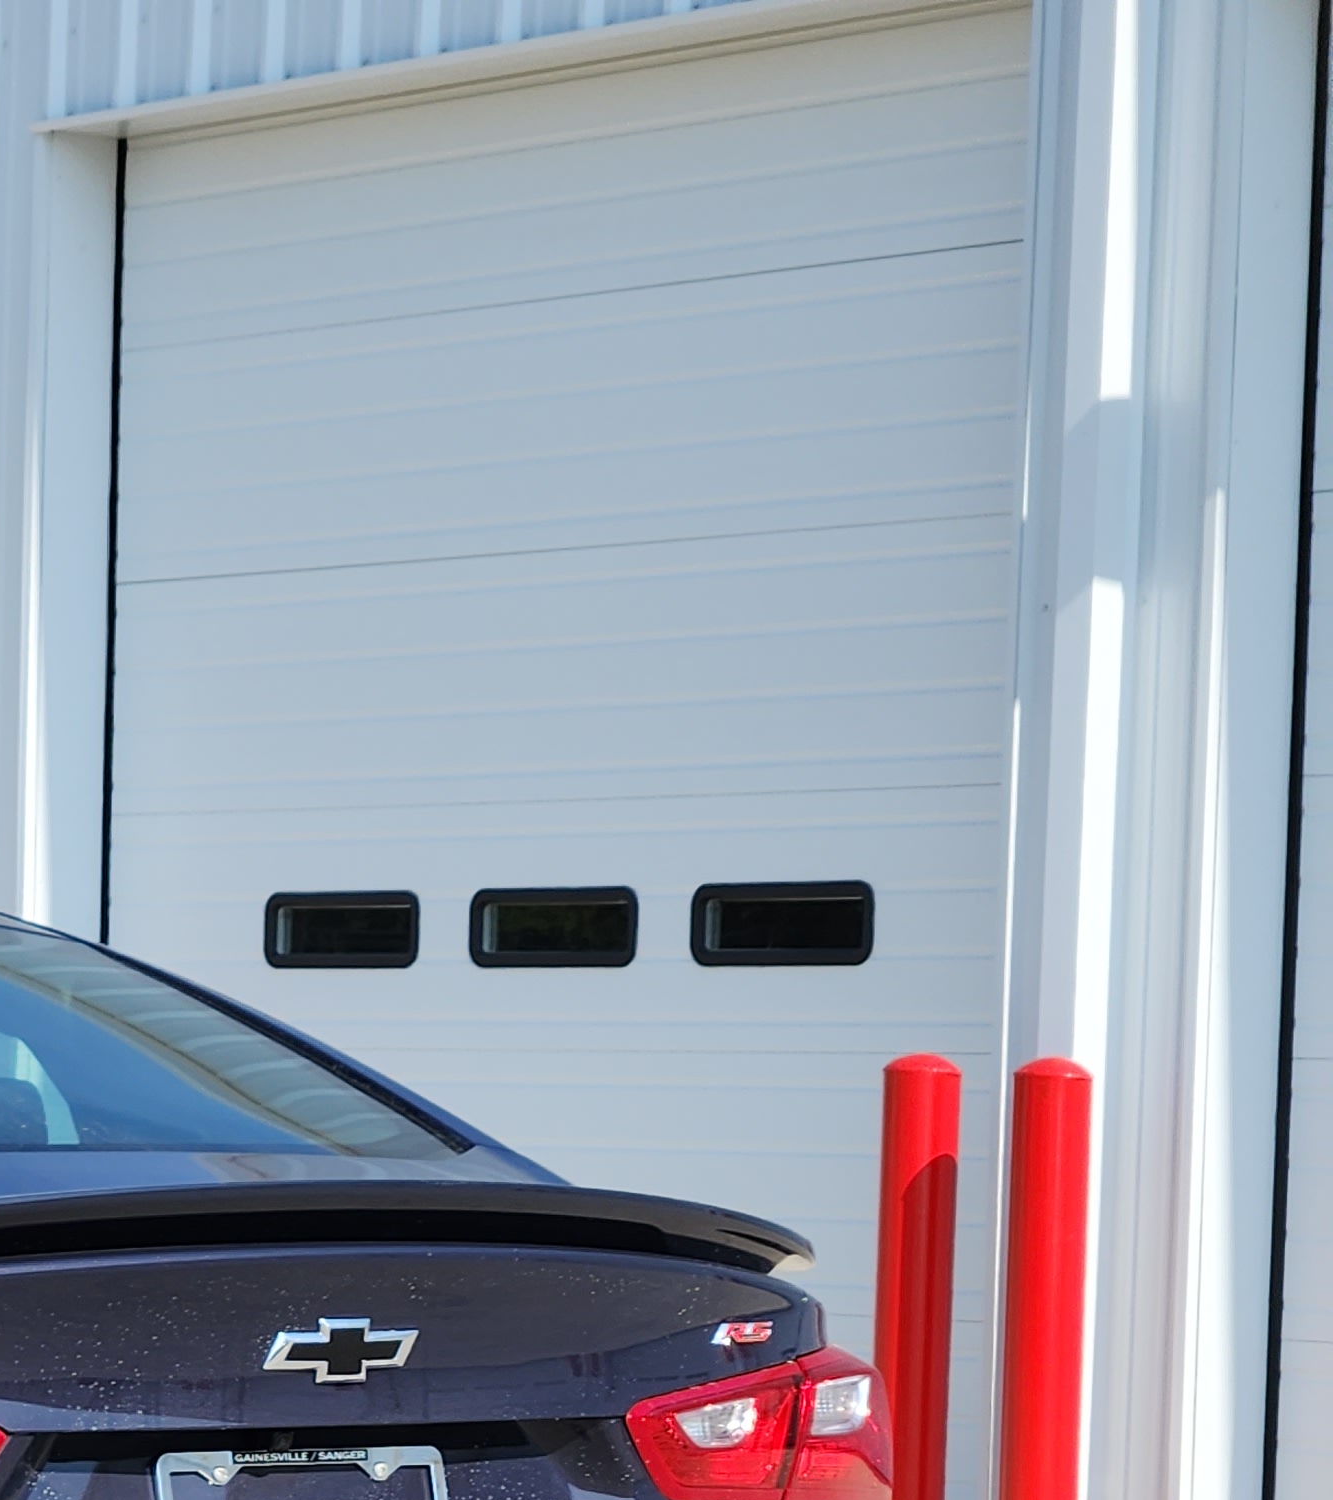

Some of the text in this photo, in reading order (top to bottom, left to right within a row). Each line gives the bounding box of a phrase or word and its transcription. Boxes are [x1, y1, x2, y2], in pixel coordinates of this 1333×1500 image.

[710, 1321, 773, 1346] RS
[234, 1452, 309, 1463] GAINESVILLE
[318, 1450, 367, 1461] SANGER
